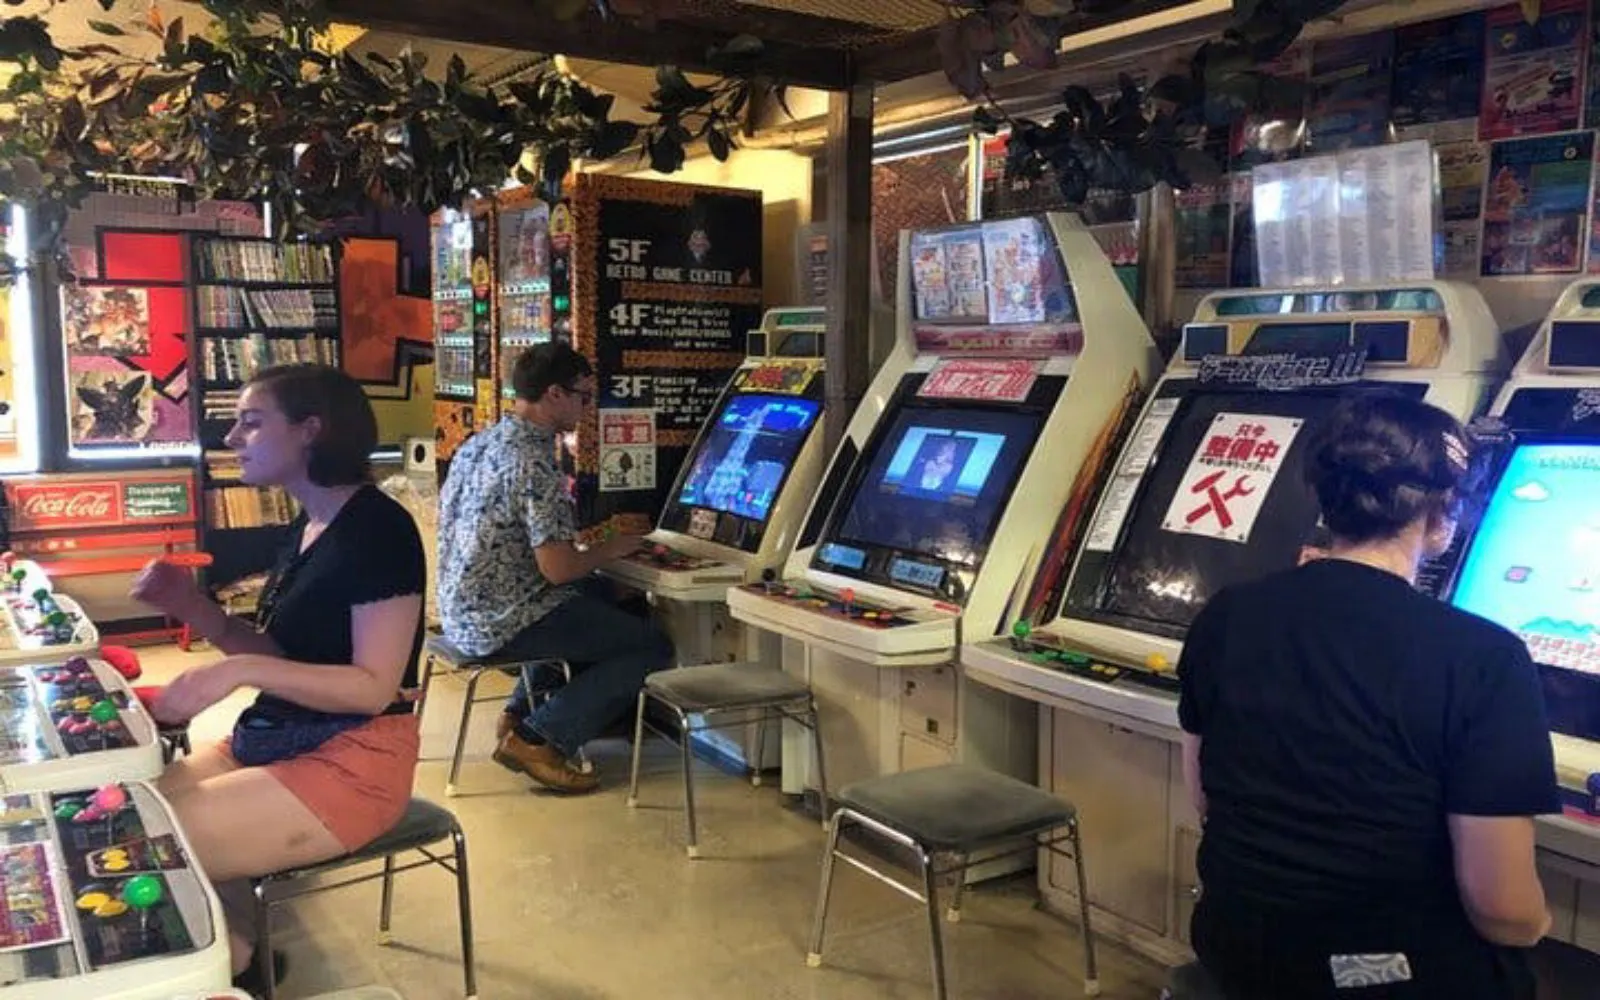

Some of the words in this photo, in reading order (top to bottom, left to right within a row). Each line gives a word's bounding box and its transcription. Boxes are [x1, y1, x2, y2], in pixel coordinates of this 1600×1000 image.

[608, 238, 652, 262] 5F
[653, 266, 682, 282] GAME
[689, 268, 733, 284] CENTER
[609, 303, 652, 327] 4F
[610, 376, 652, 398] 3F
